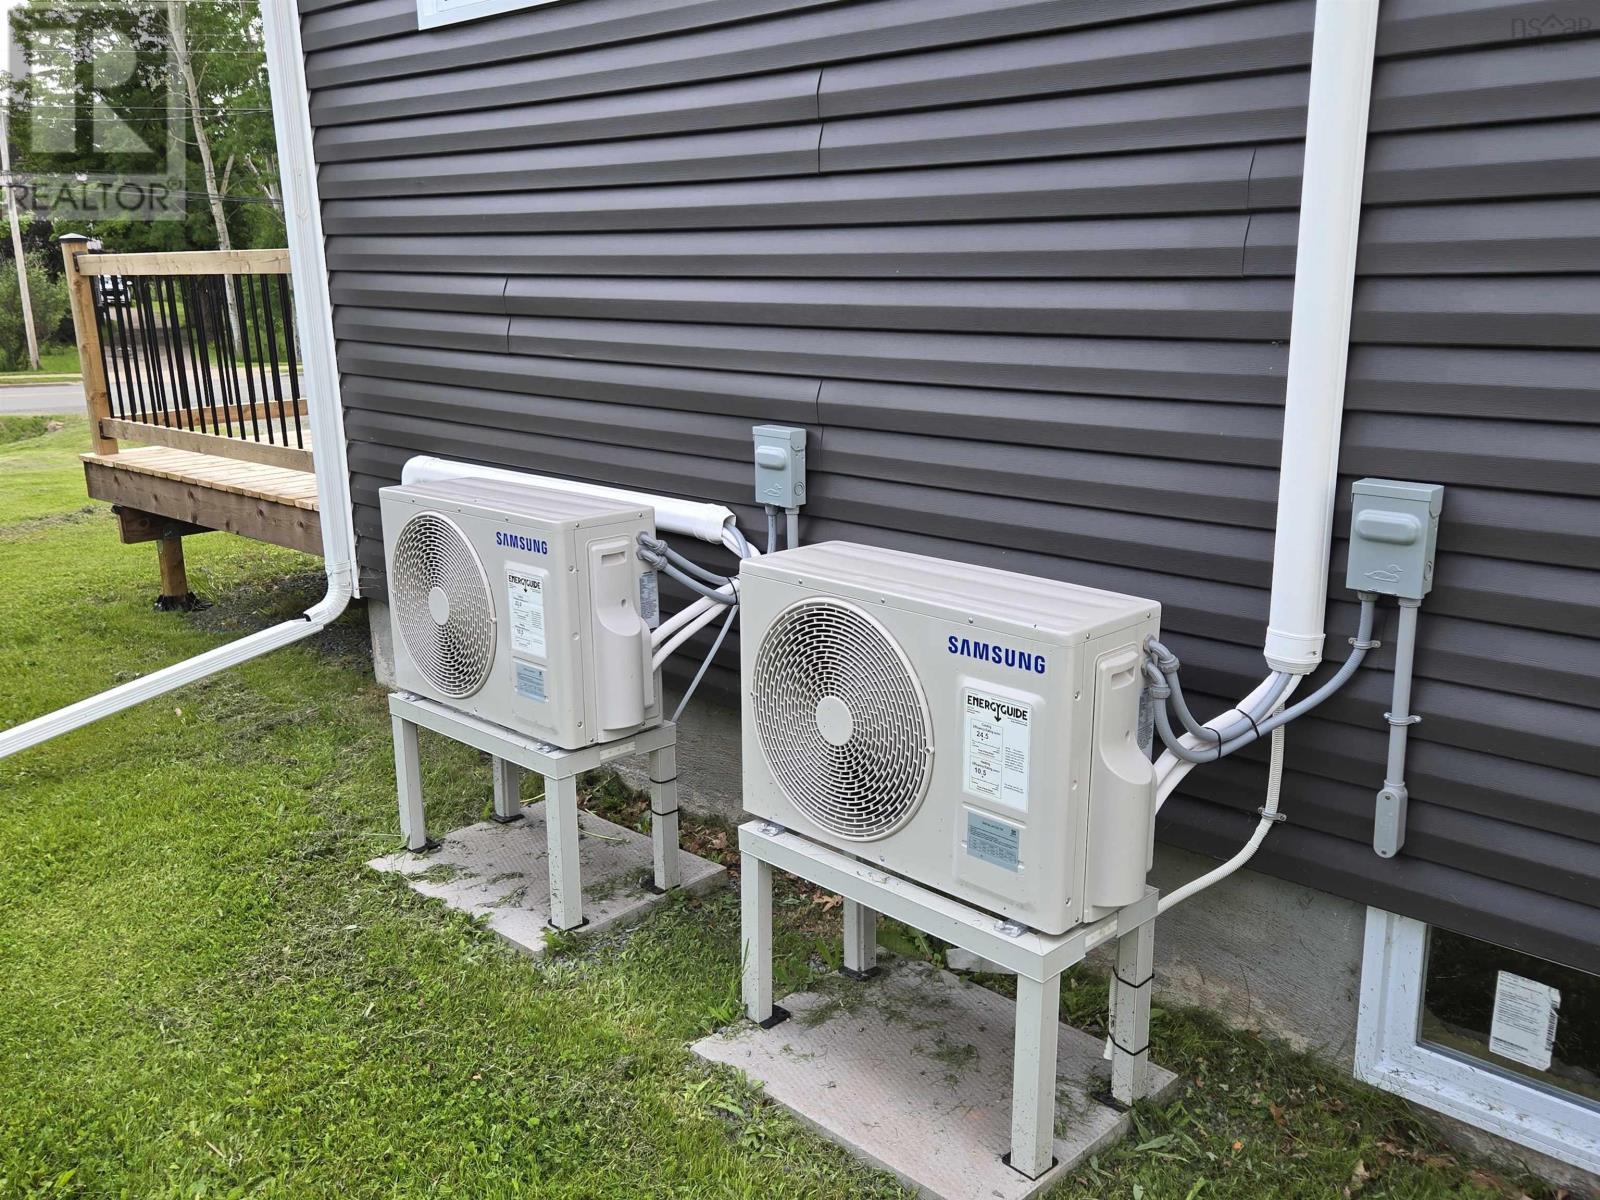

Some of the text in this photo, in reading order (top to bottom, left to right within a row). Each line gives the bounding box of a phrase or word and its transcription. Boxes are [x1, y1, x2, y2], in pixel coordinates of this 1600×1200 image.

[496, 531, 548, 555] SAMSUNG
[948, 635, 1046, 674] SAMSUNG
[967, 695, 1028, 721] ENERGYGUIDE
[974, 767, 987, 777] 10.5
